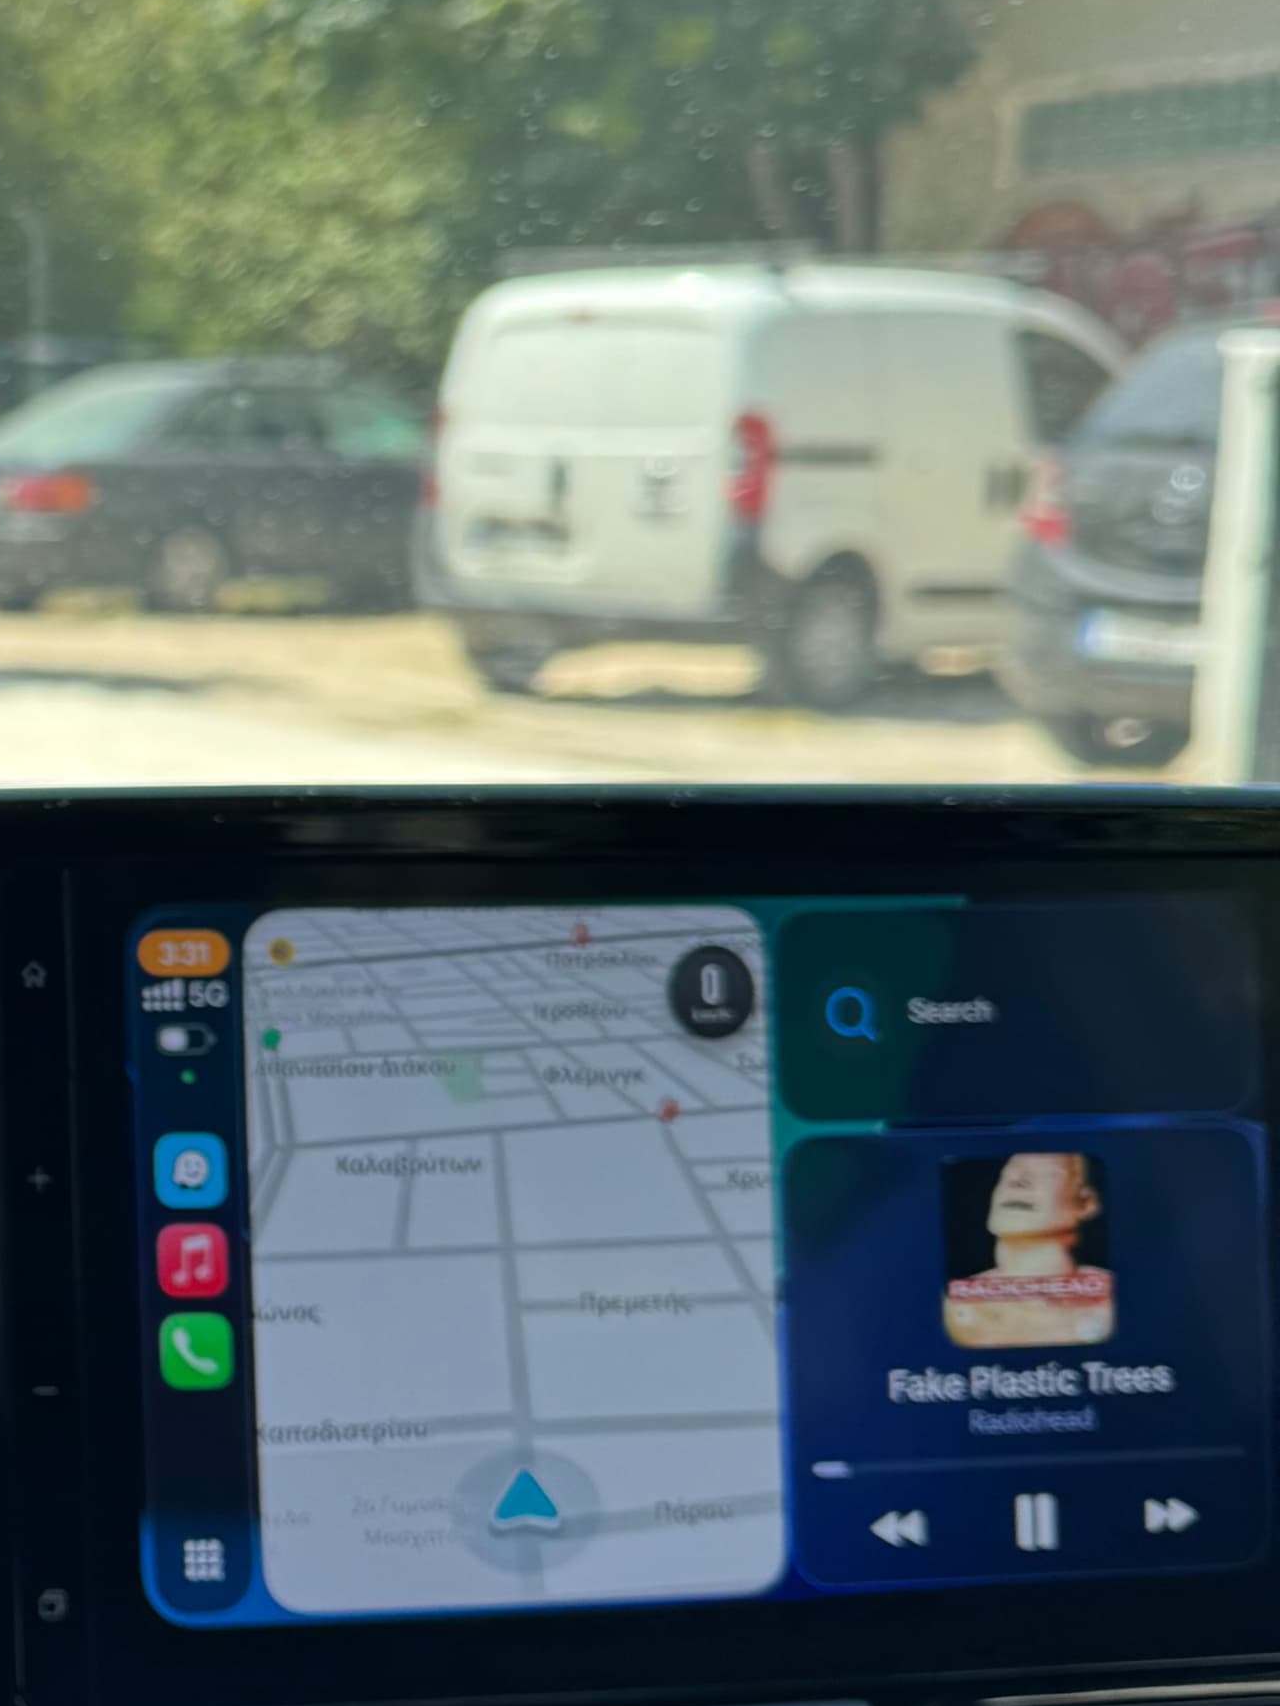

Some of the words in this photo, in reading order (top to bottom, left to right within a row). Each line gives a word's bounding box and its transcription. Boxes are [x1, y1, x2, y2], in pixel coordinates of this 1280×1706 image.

[157, 941, 211, 966] 3:31
[188, 980, 229, 1007] 5G
[700, 963, 726, 1005] 0
[908, 997, 996, 1024] Search
[336, 1155, 482, 1177] Καλαβρύτων
[578, 1291, 693, 1318] Πρεμετής
[888, 1368, 966, 1403] Fake
[970, 1363, 1079, 1398] Plastic
[1083, 1360, 1175, 1394] Trees
[969, 1406, 1097, 1436] Radiohead
[654, 1498, 735, 1528] Πάρου
